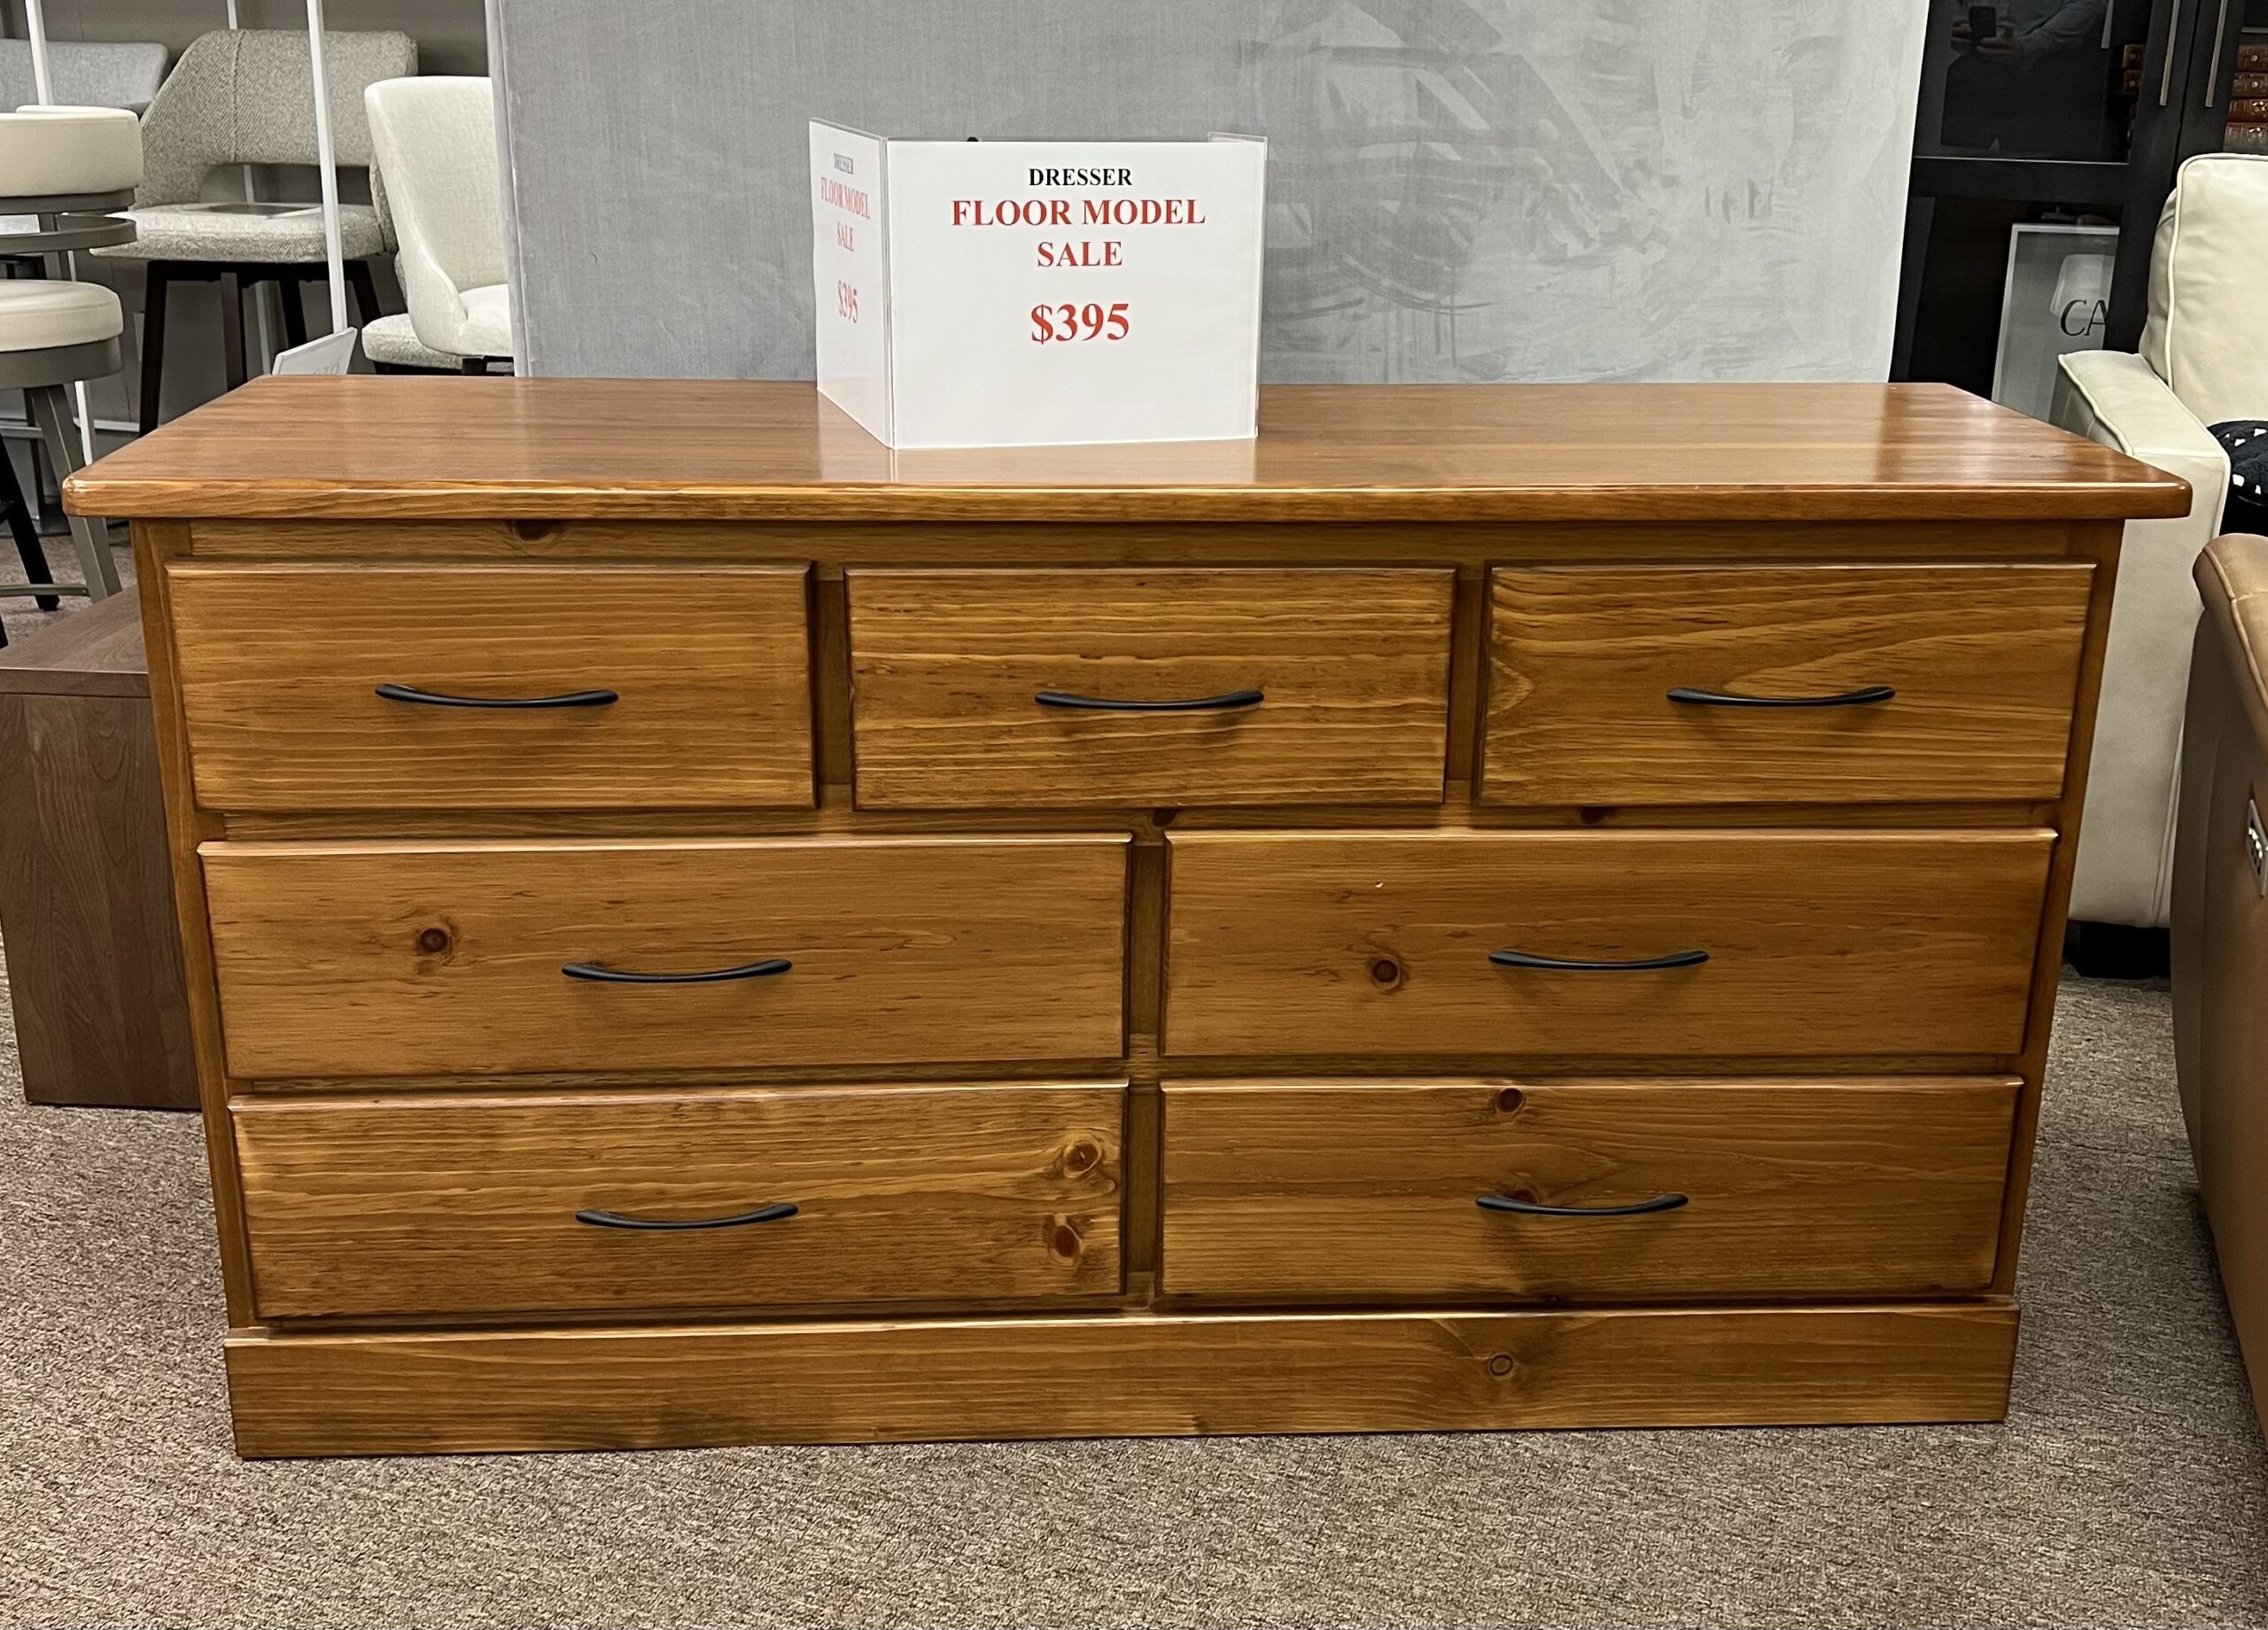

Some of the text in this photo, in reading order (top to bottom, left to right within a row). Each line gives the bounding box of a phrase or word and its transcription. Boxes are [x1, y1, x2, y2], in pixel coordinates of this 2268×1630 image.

[1029, 167, 1133, 186] DRESSER
[820, 176, 870, 221] FLOOR MODEL
[951, 198, 1206, 227] FLOOR MODEL
[836, 221, 855, 252] SALE
[1037, 241, 1123, 268] SALE
[837, 279, 858, 324] $395
[1030, 303, 1130, 345] $395
